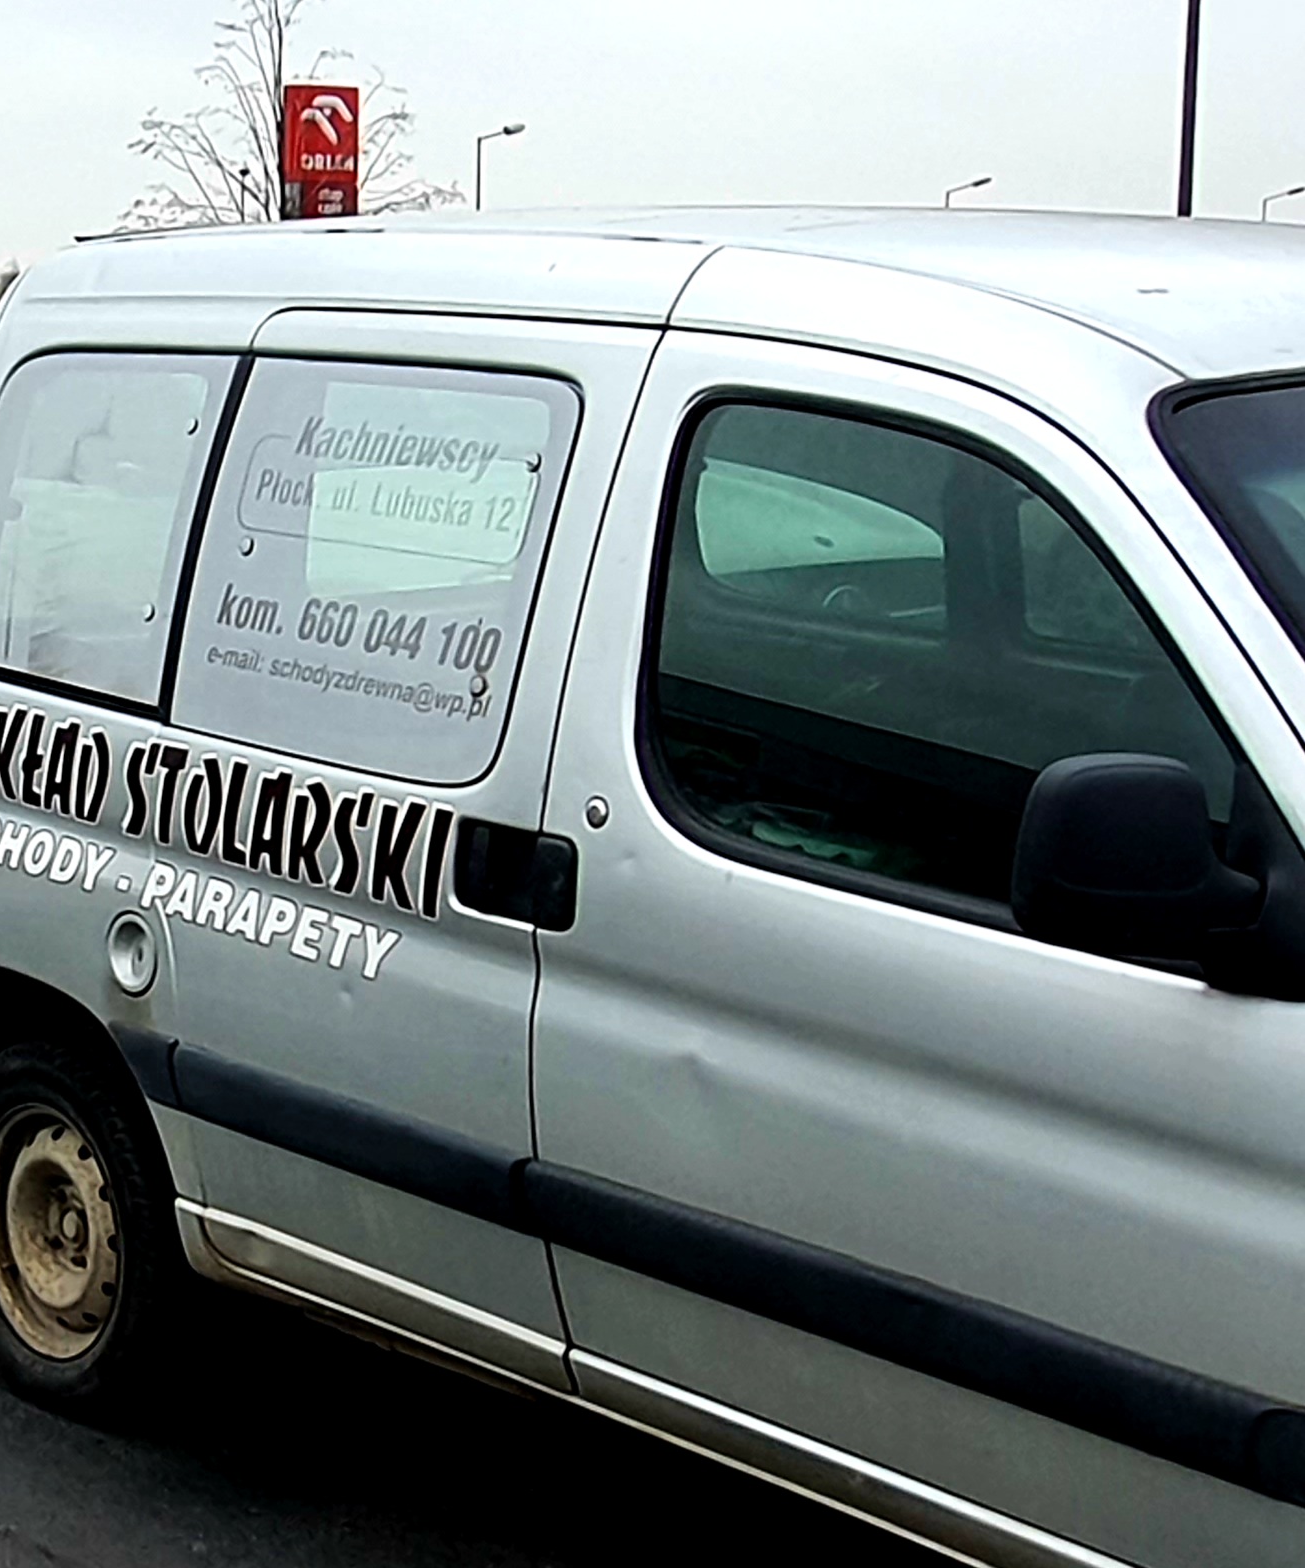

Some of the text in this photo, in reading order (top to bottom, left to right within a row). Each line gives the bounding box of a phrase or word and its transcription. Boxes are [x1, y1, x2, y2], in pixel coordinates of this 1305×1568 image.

[294, 415, 500, 484] Kachniewscy
[330, 479, 361, 513] ul.
[370, 481, 474, 527] Lubuska
[216, 582, 503, 674] kom. 660 044 100
[206, 642, 493, 722] e-mail: schodyzdrewna@wp.pl
[122, 739, 454, 921] STOLARSKI
[140, 859, 403, 981] PARAPETY
